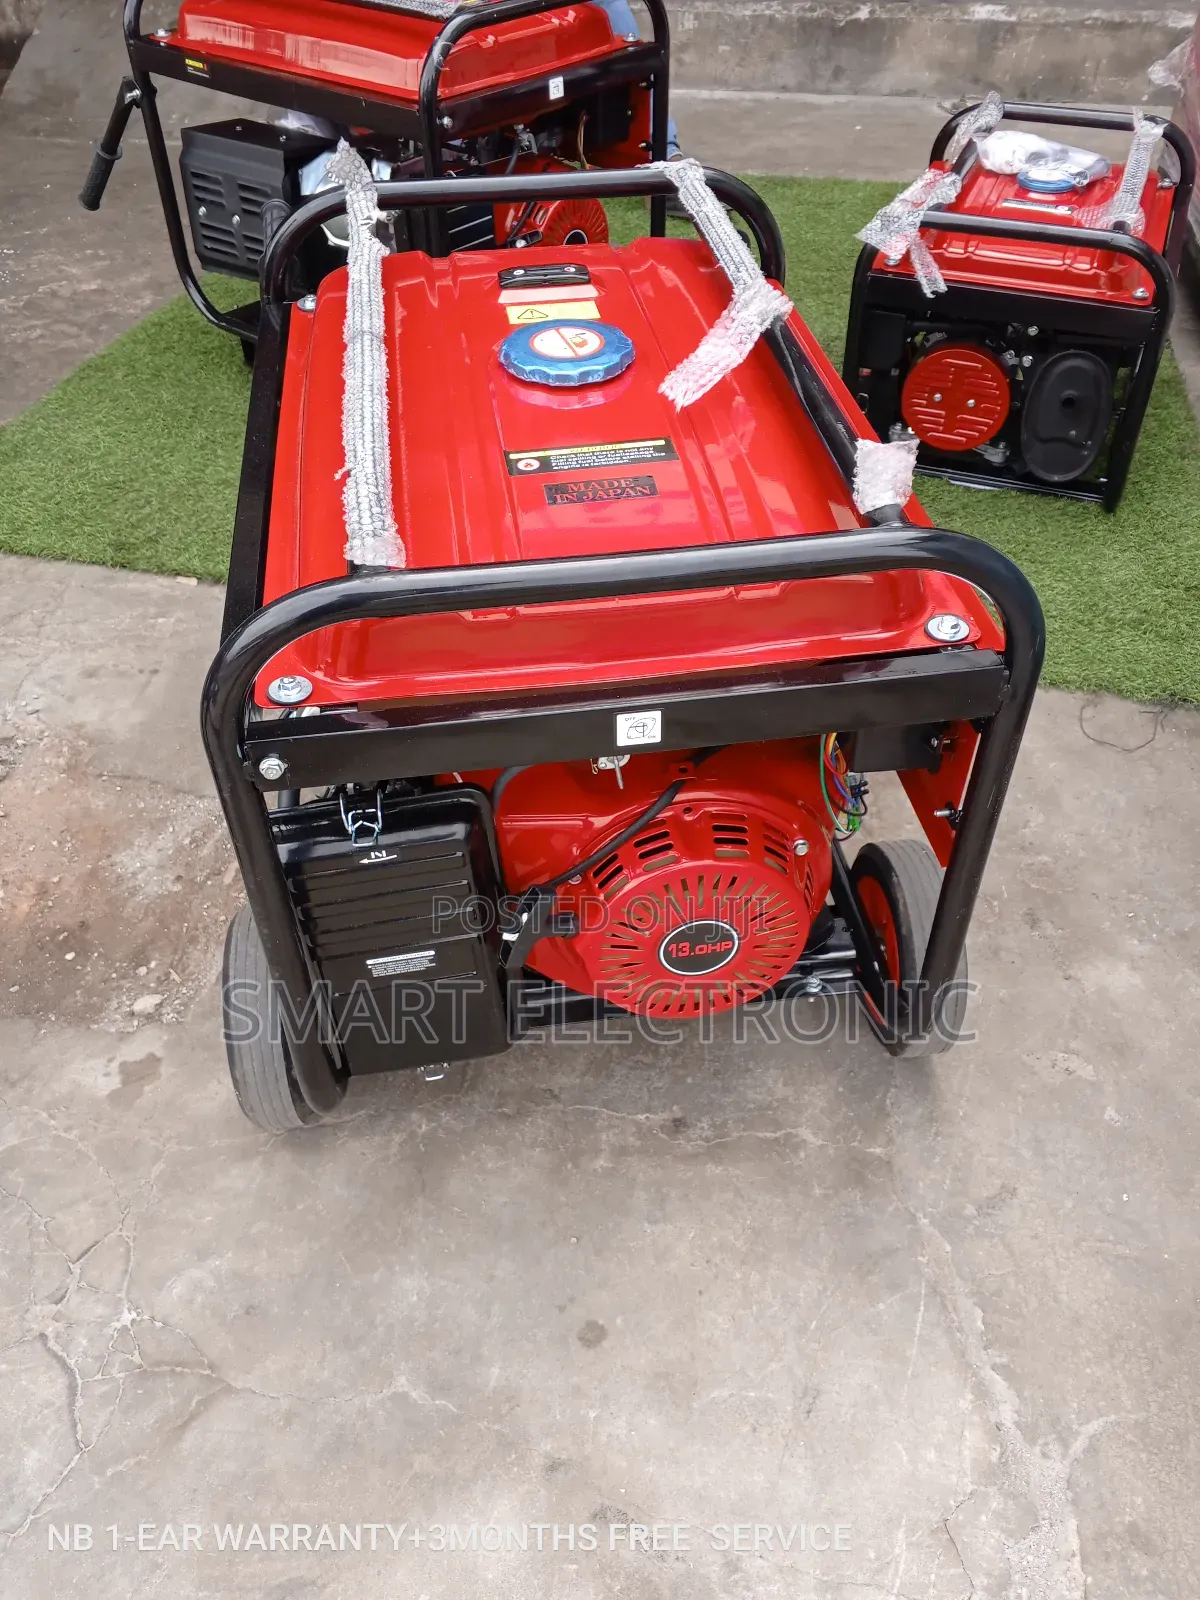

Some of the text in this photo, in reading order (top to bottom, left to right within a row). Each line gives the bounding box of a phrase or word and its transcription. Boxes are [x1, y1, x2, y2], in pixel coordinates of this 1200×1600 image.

[568, 478, 635, 492] MADE
[554, 486, 651, 503] IN JAPAN
[668, 941, 733, 957] 13.0HP
